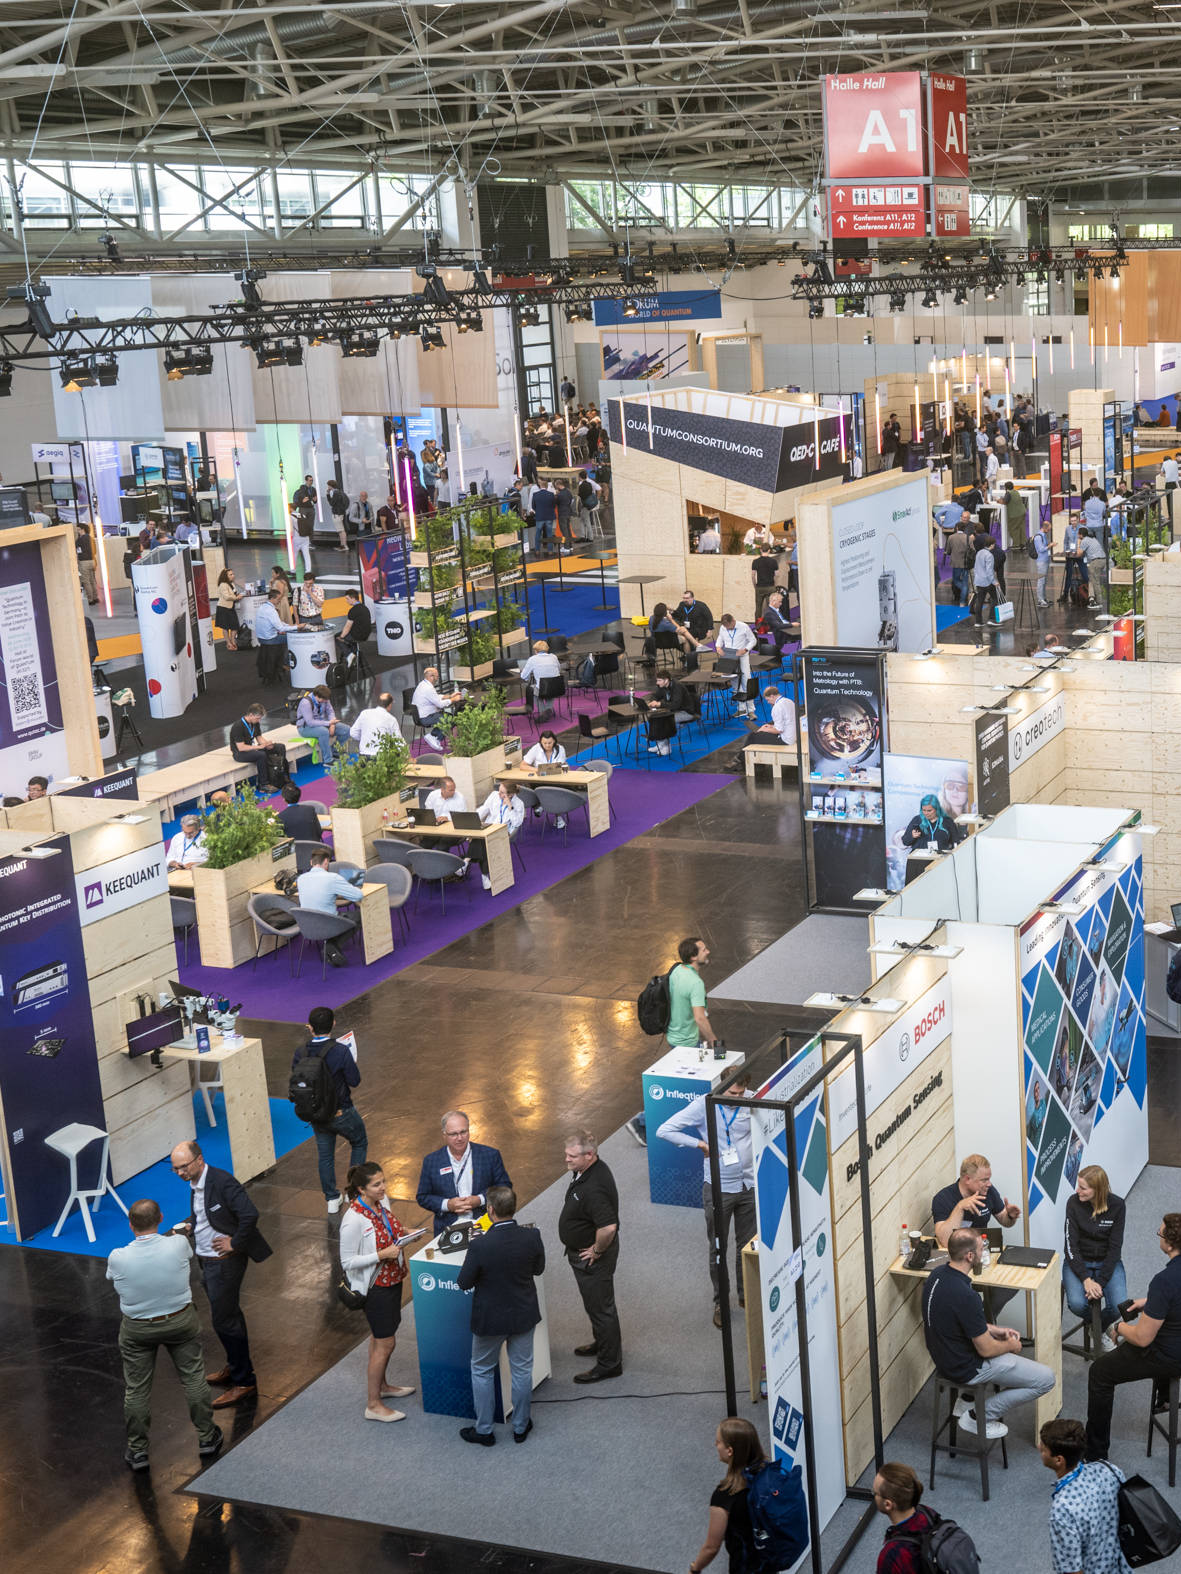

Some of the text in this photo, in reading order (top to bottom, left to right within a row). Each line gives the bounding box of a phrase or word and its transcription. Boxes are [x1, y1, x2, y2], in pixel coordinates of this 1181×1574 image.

[831, 77, 886, 90] Halle Hall
[933, 77, 955, 91] Halle Hall
[857, 109, 917, 153] A1
[945, 112, 967, 154] A1
[853, 214, 884, 222] Konferenz
[853, 223, 888, 232] Conference
[661, 308, 692, 318] QUANTUM
[626, 419, 764, 459] QUANTUMCONSORTIUM.ORG
[820, 434, 840, 454] CAFÉ
[839, 528, 876, 550] CRYOGENIC STAGES
[841, 688, 873, 696] Technology
[1025, 704, 1063, 746] creotech
[103, 777, 134, 794] KEEQUANT
[105, 863, 161, 896] KEEQUANT
[1026, 932, 1044, 955] Leading
[1107, 931, 1128, 960] EXPLORATION
[1076, 970, 1095, 998] CONSUMER
[1076, 988, 1090, 1008] GOODS
[914, 1000, 946, 1045] BOSCH
[1031, 1010, 1048, 1032] MEDICAL
[1031, 1012, 1056, 1045] APPLICATIONS
[666, 1088, 701, 1102] Infleqtio
[874, 1103, 912, 1151] Quantum
[912, 1070, 943, 1110] Sensing
[1040, 1138, 1057, 1164] PROCESS
[1040, 1136, 1068, 1176] IMPROVEMENTS
